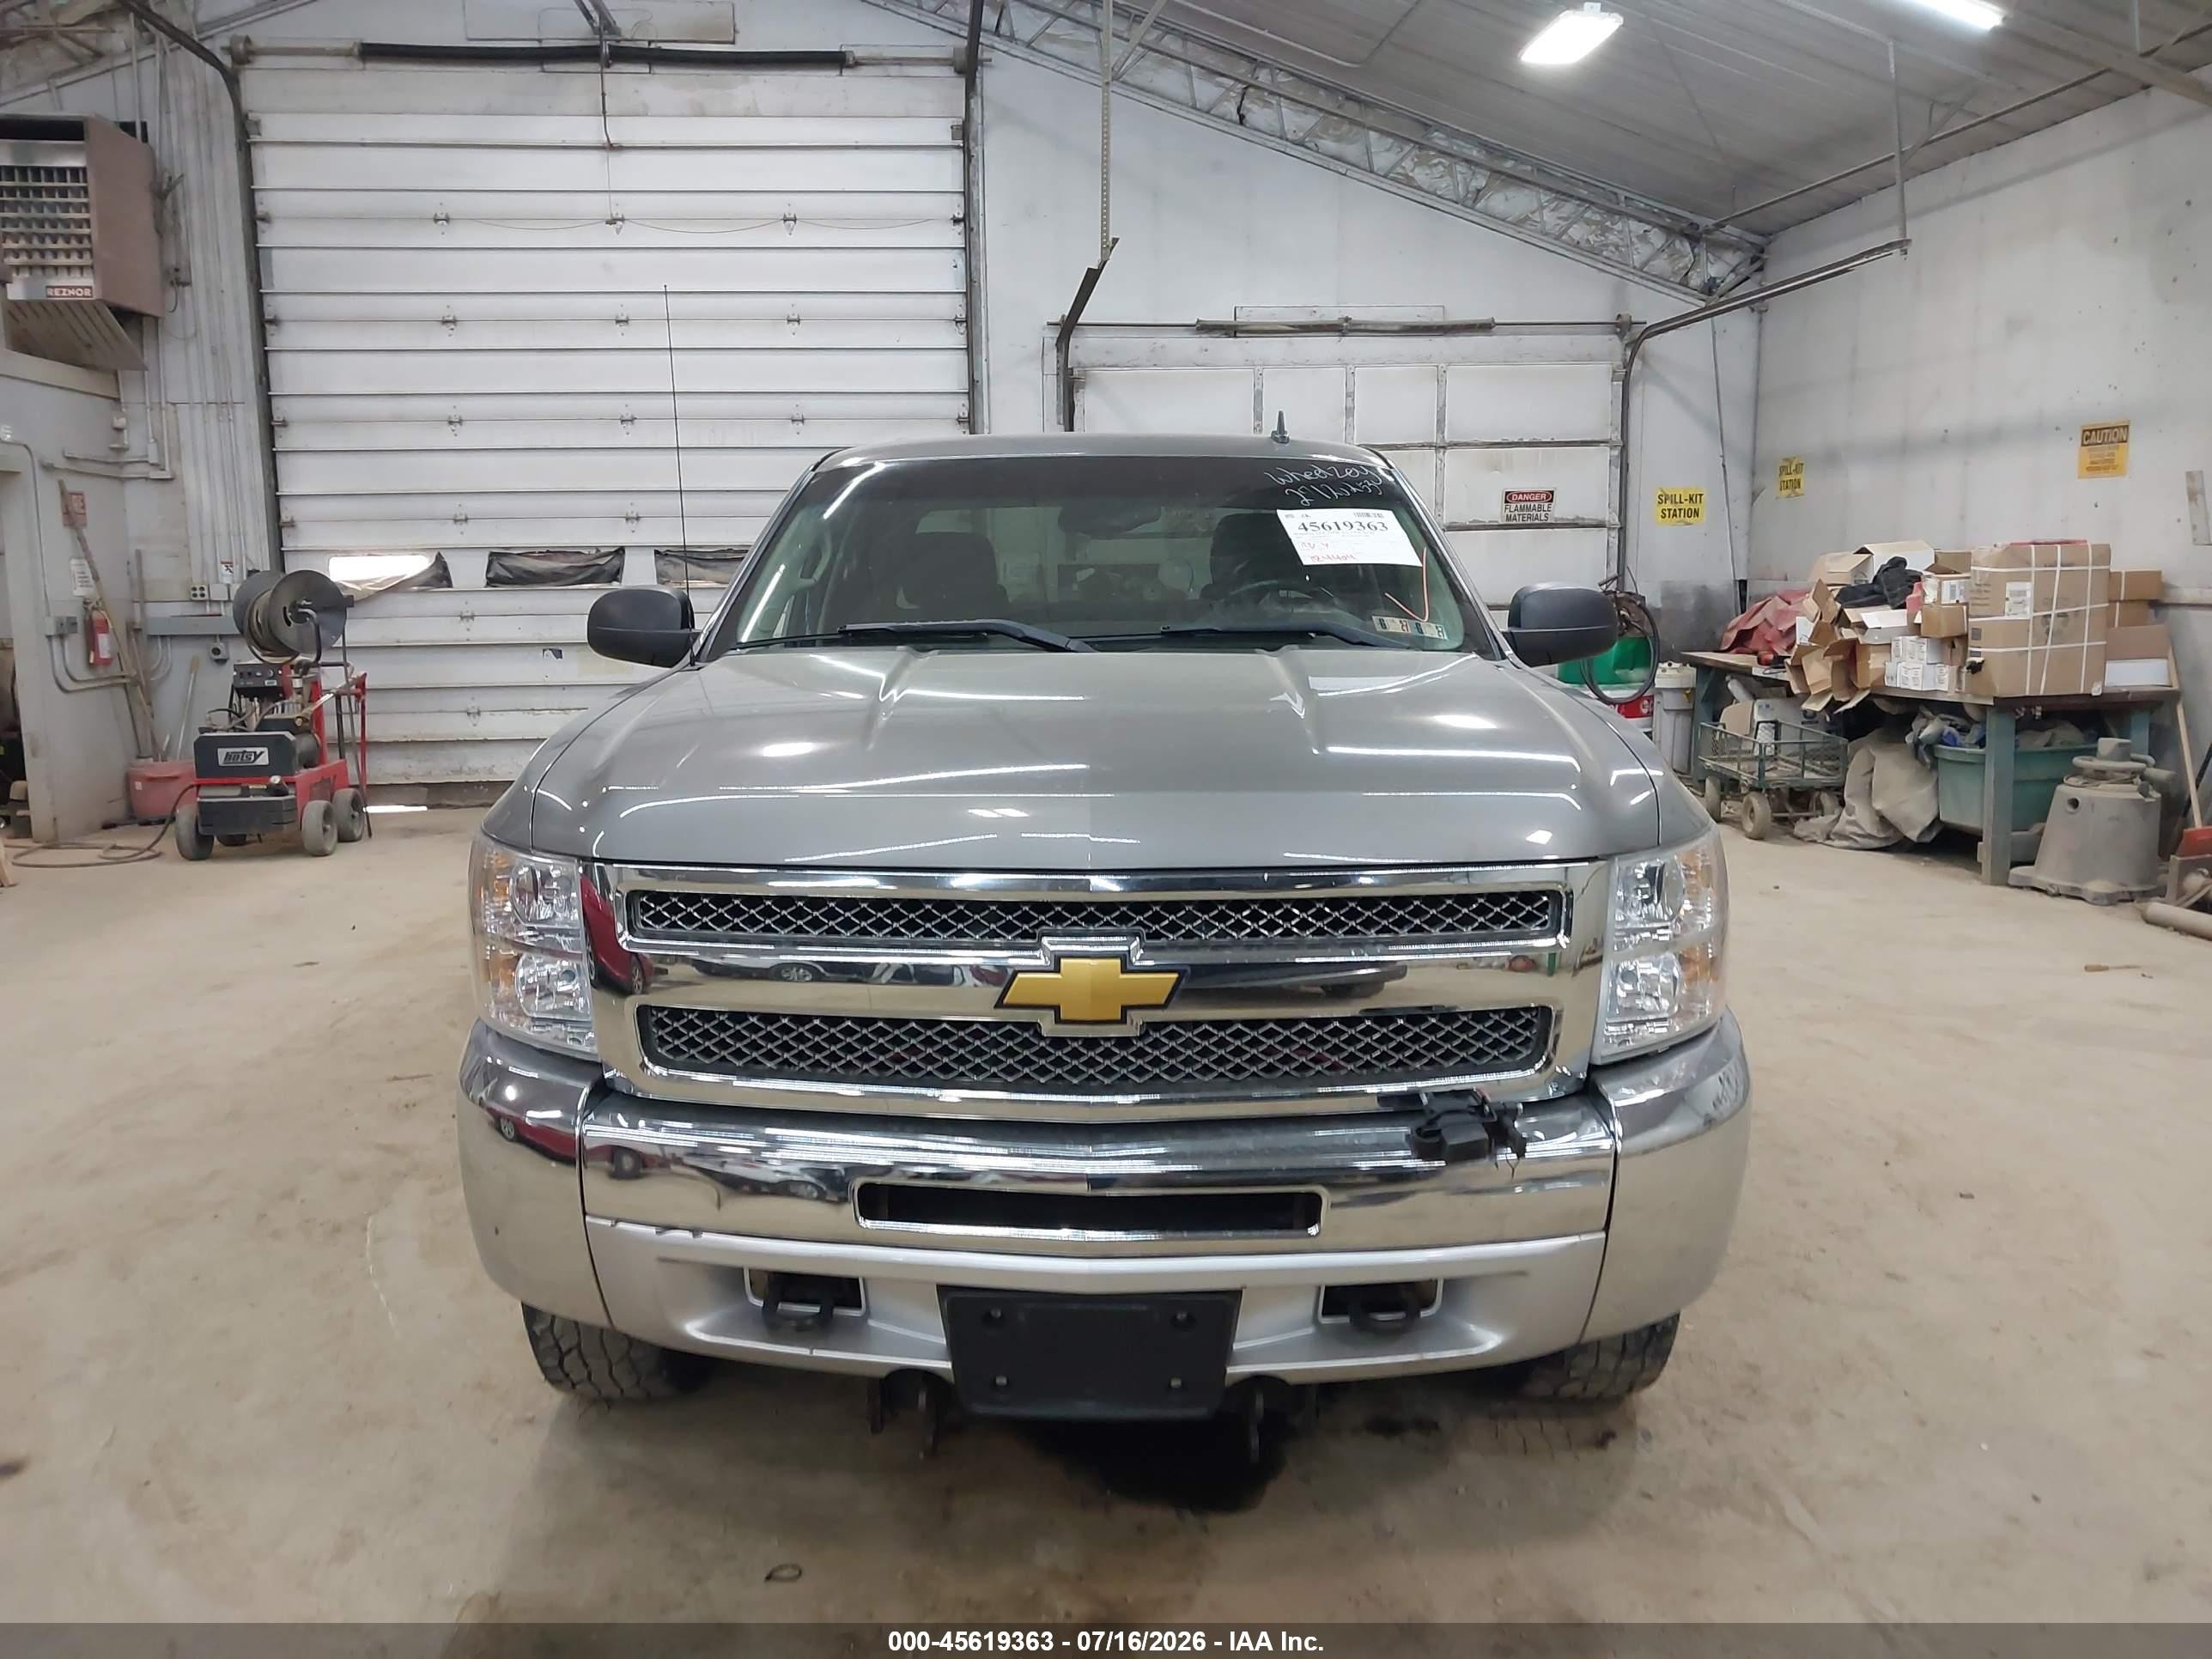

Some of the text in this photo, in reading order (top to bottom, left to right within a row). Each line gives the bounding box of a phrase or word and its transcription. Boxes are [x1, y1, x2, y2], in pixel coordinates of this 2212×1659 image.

[46, 288, 91, 296] REZNOR
[2082, 428, 2128, 445] CAUTION
[1657, 494, 1705, 505] SPILL-KIT
[1504, 503, 1552, 513] FLAMMABLE
[1661, 507, 1700, 519] STATION
[1505, 514, 1549, 522] MATERIALS
[1297, 520, 1389, 532] 45619363
